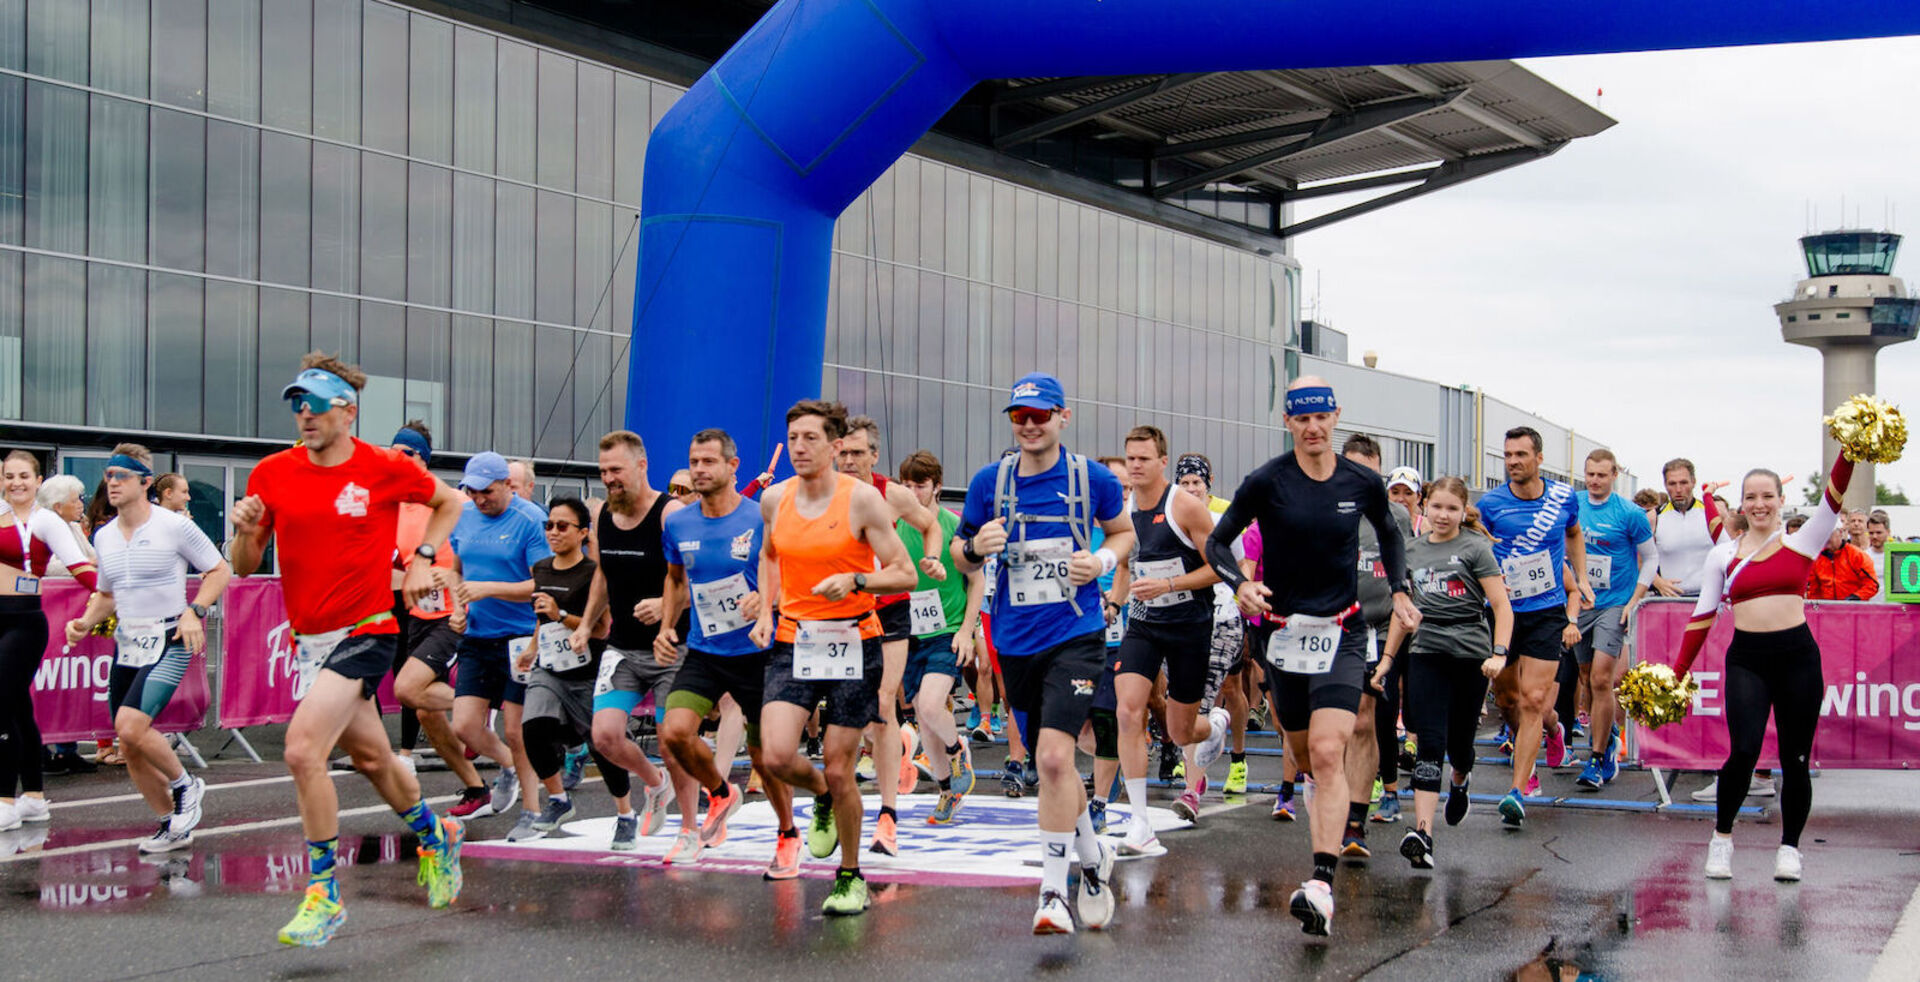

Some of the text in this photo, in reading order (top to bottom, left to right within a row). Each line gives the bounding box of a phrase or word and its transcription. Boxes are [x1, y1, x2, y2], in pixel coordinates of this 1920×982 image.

[1032, 560, 1069, 581] 226
[1528, 567, 1546, 581] 95
[1900, 554, 1920, 593] 0
[913, 605, 939, 620] 146
[554, 637, 573, 653] 30
[827, 642, 849, 658] 37
[1300, 635, 1332, 653] 180
